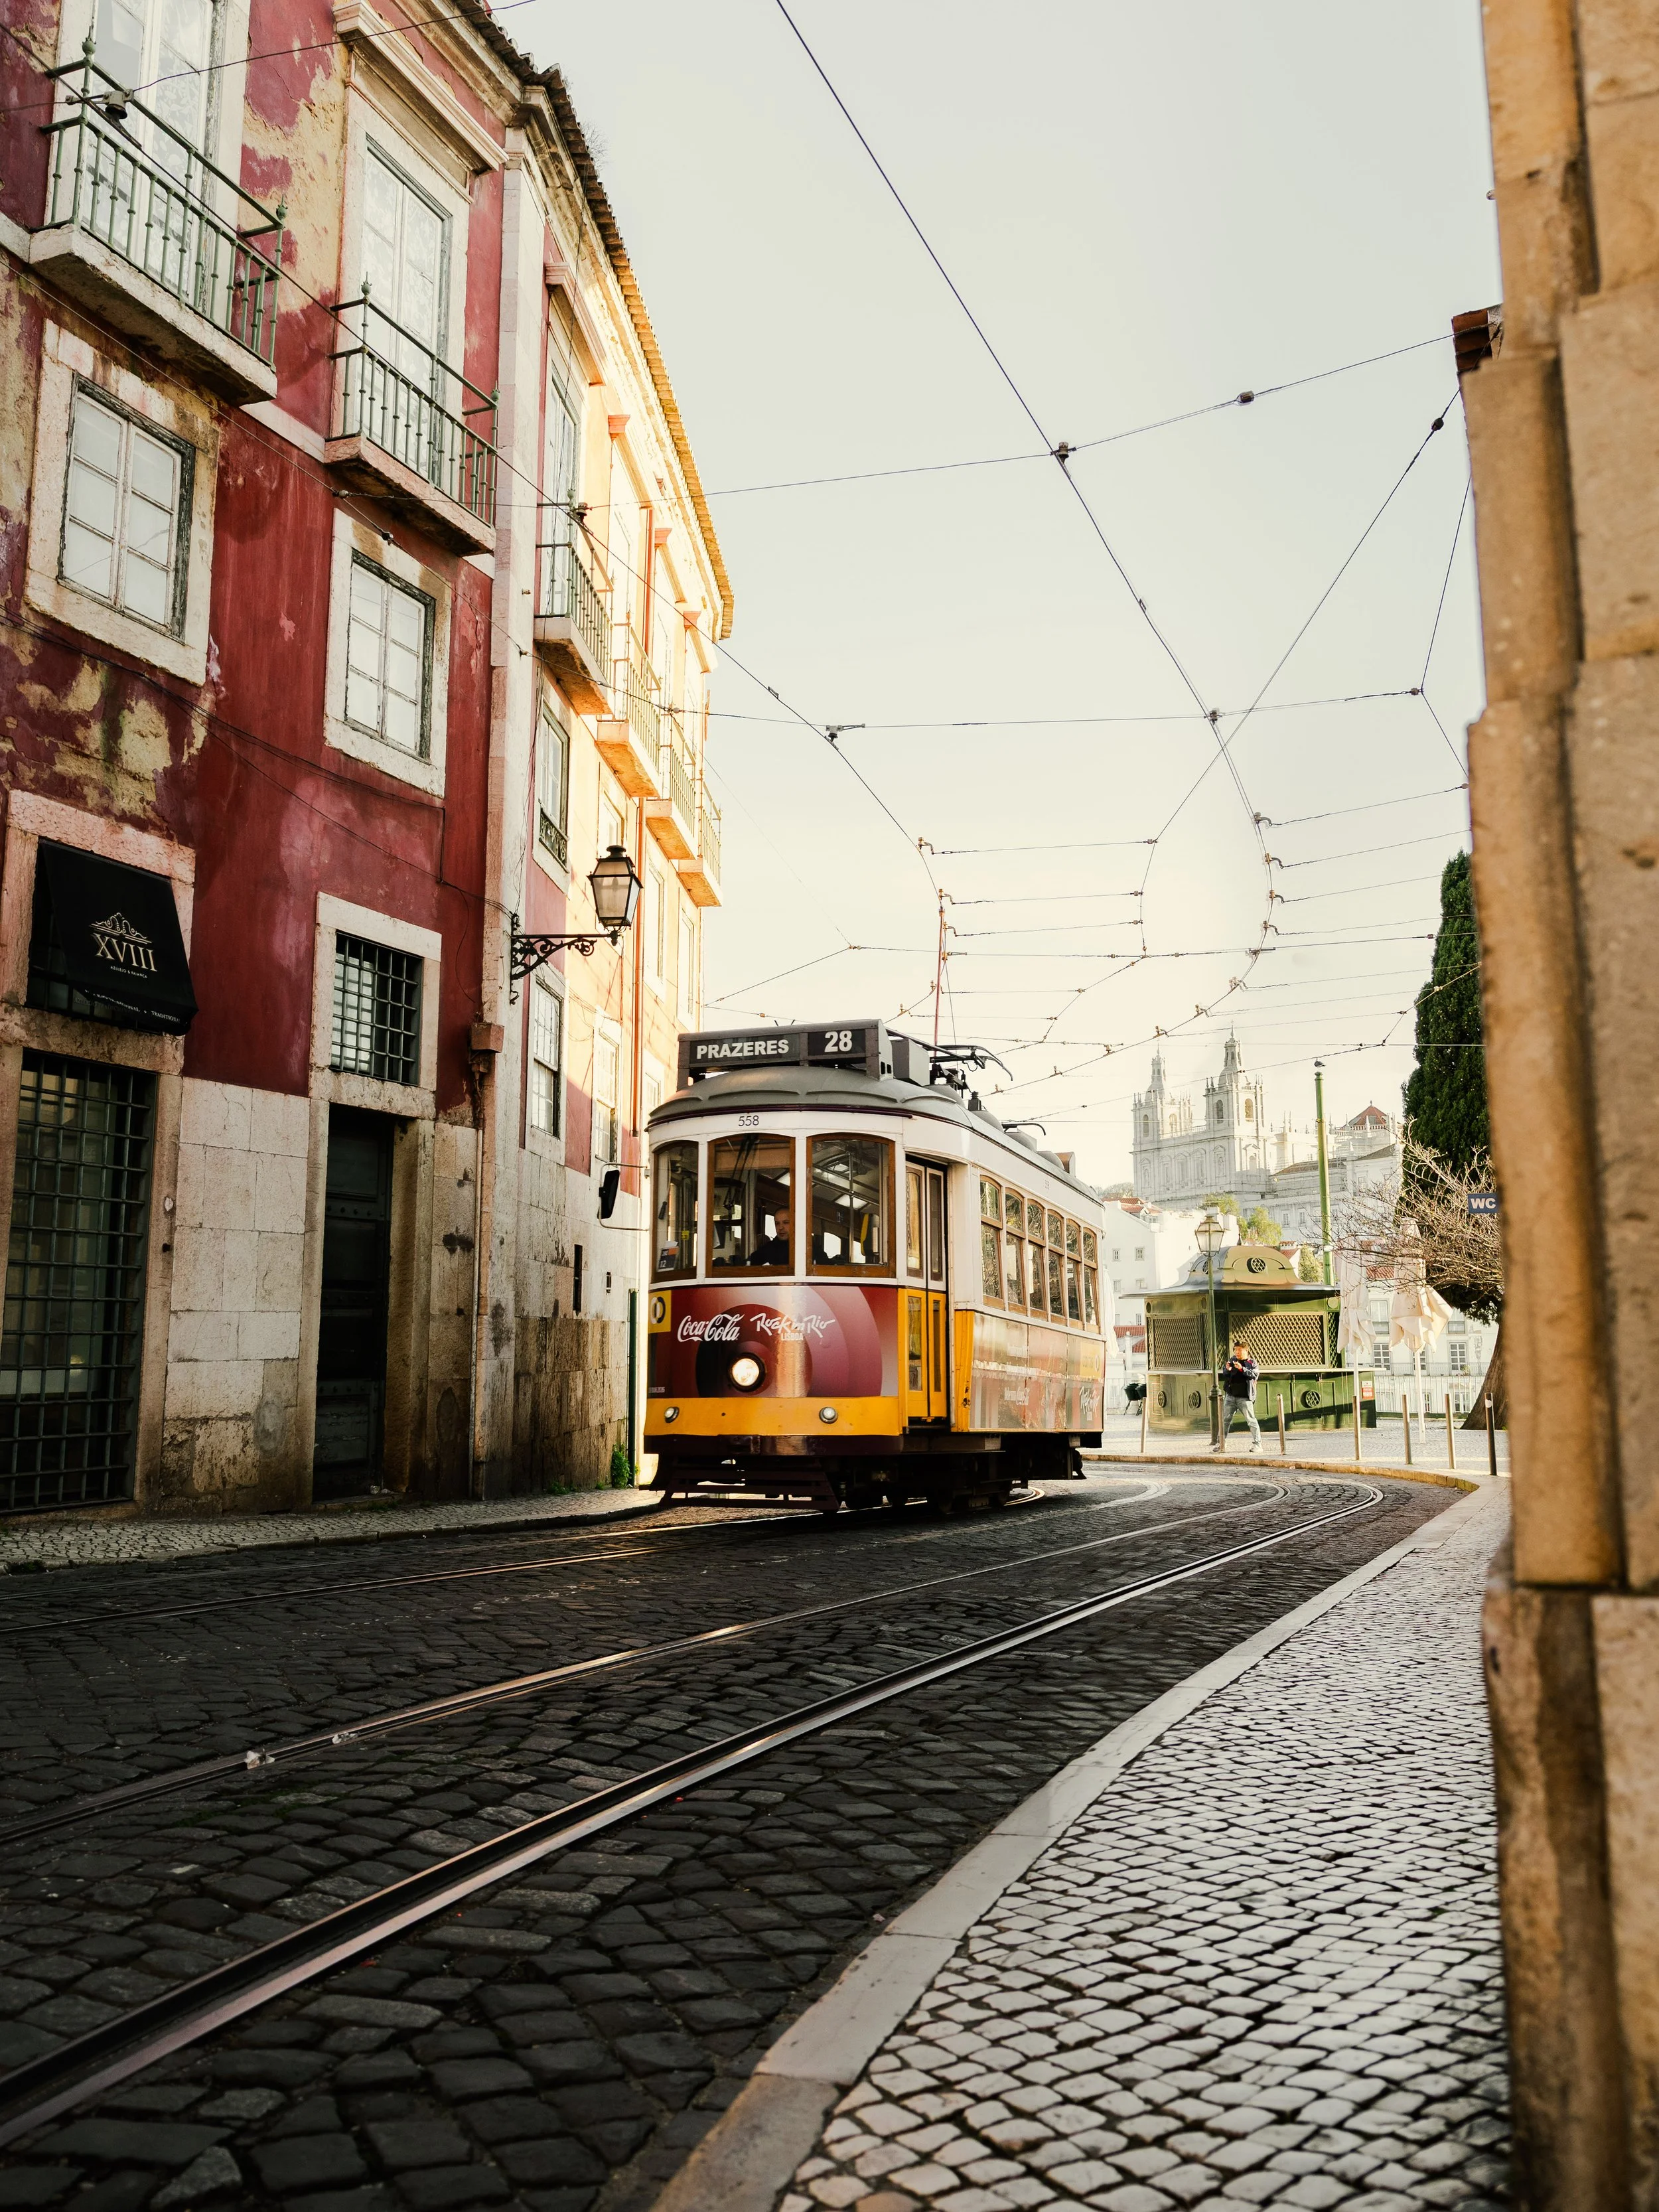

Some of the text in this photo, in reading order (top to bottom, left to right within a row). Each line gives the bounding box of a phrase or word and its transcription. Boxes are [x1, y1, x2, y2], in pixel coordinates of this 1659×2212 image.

[92, 932, 157, 972] XVIII
[697, 1039, 789, 1059] PRAZERES
[824, 1030, 852, 1053] 28
[738, 1115, 759, 1126] 558
[1471, 1197, 1496, 1209] WC
[678, 1313, 745, 1342] Coca-Cola
[750, 1313, 792, 1336] Rock
[803, 1315, 835, 1338] Rio
[780, 1333, 804, 1341] LISBOA
